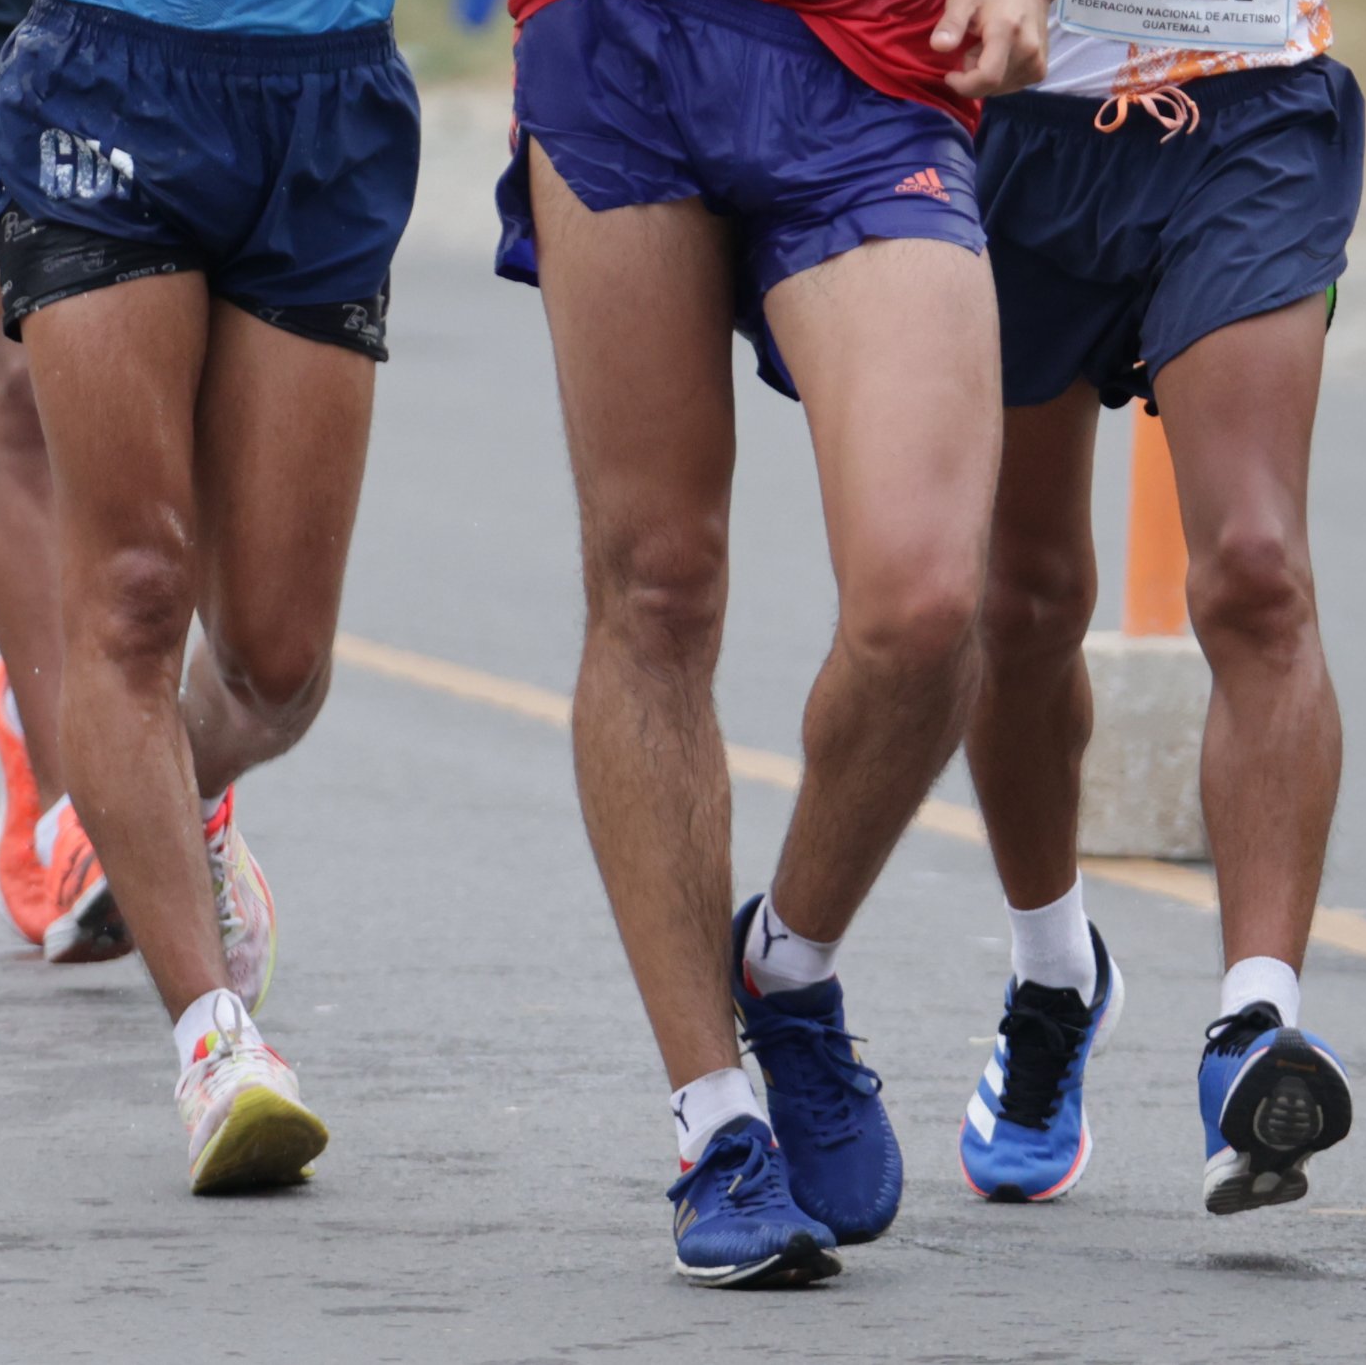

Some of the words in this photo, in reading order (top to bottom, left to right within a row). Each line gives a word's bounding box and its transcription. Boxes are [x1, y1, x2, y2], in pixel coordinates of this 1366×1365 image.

[1146, 7, 1202, 21] NACIONAL
[1205, 11, 1221, 21] DE
[1222, 12, 1281, 24] ATLETISMO
[1142, 20, 1211, 34] GUATEMALA
